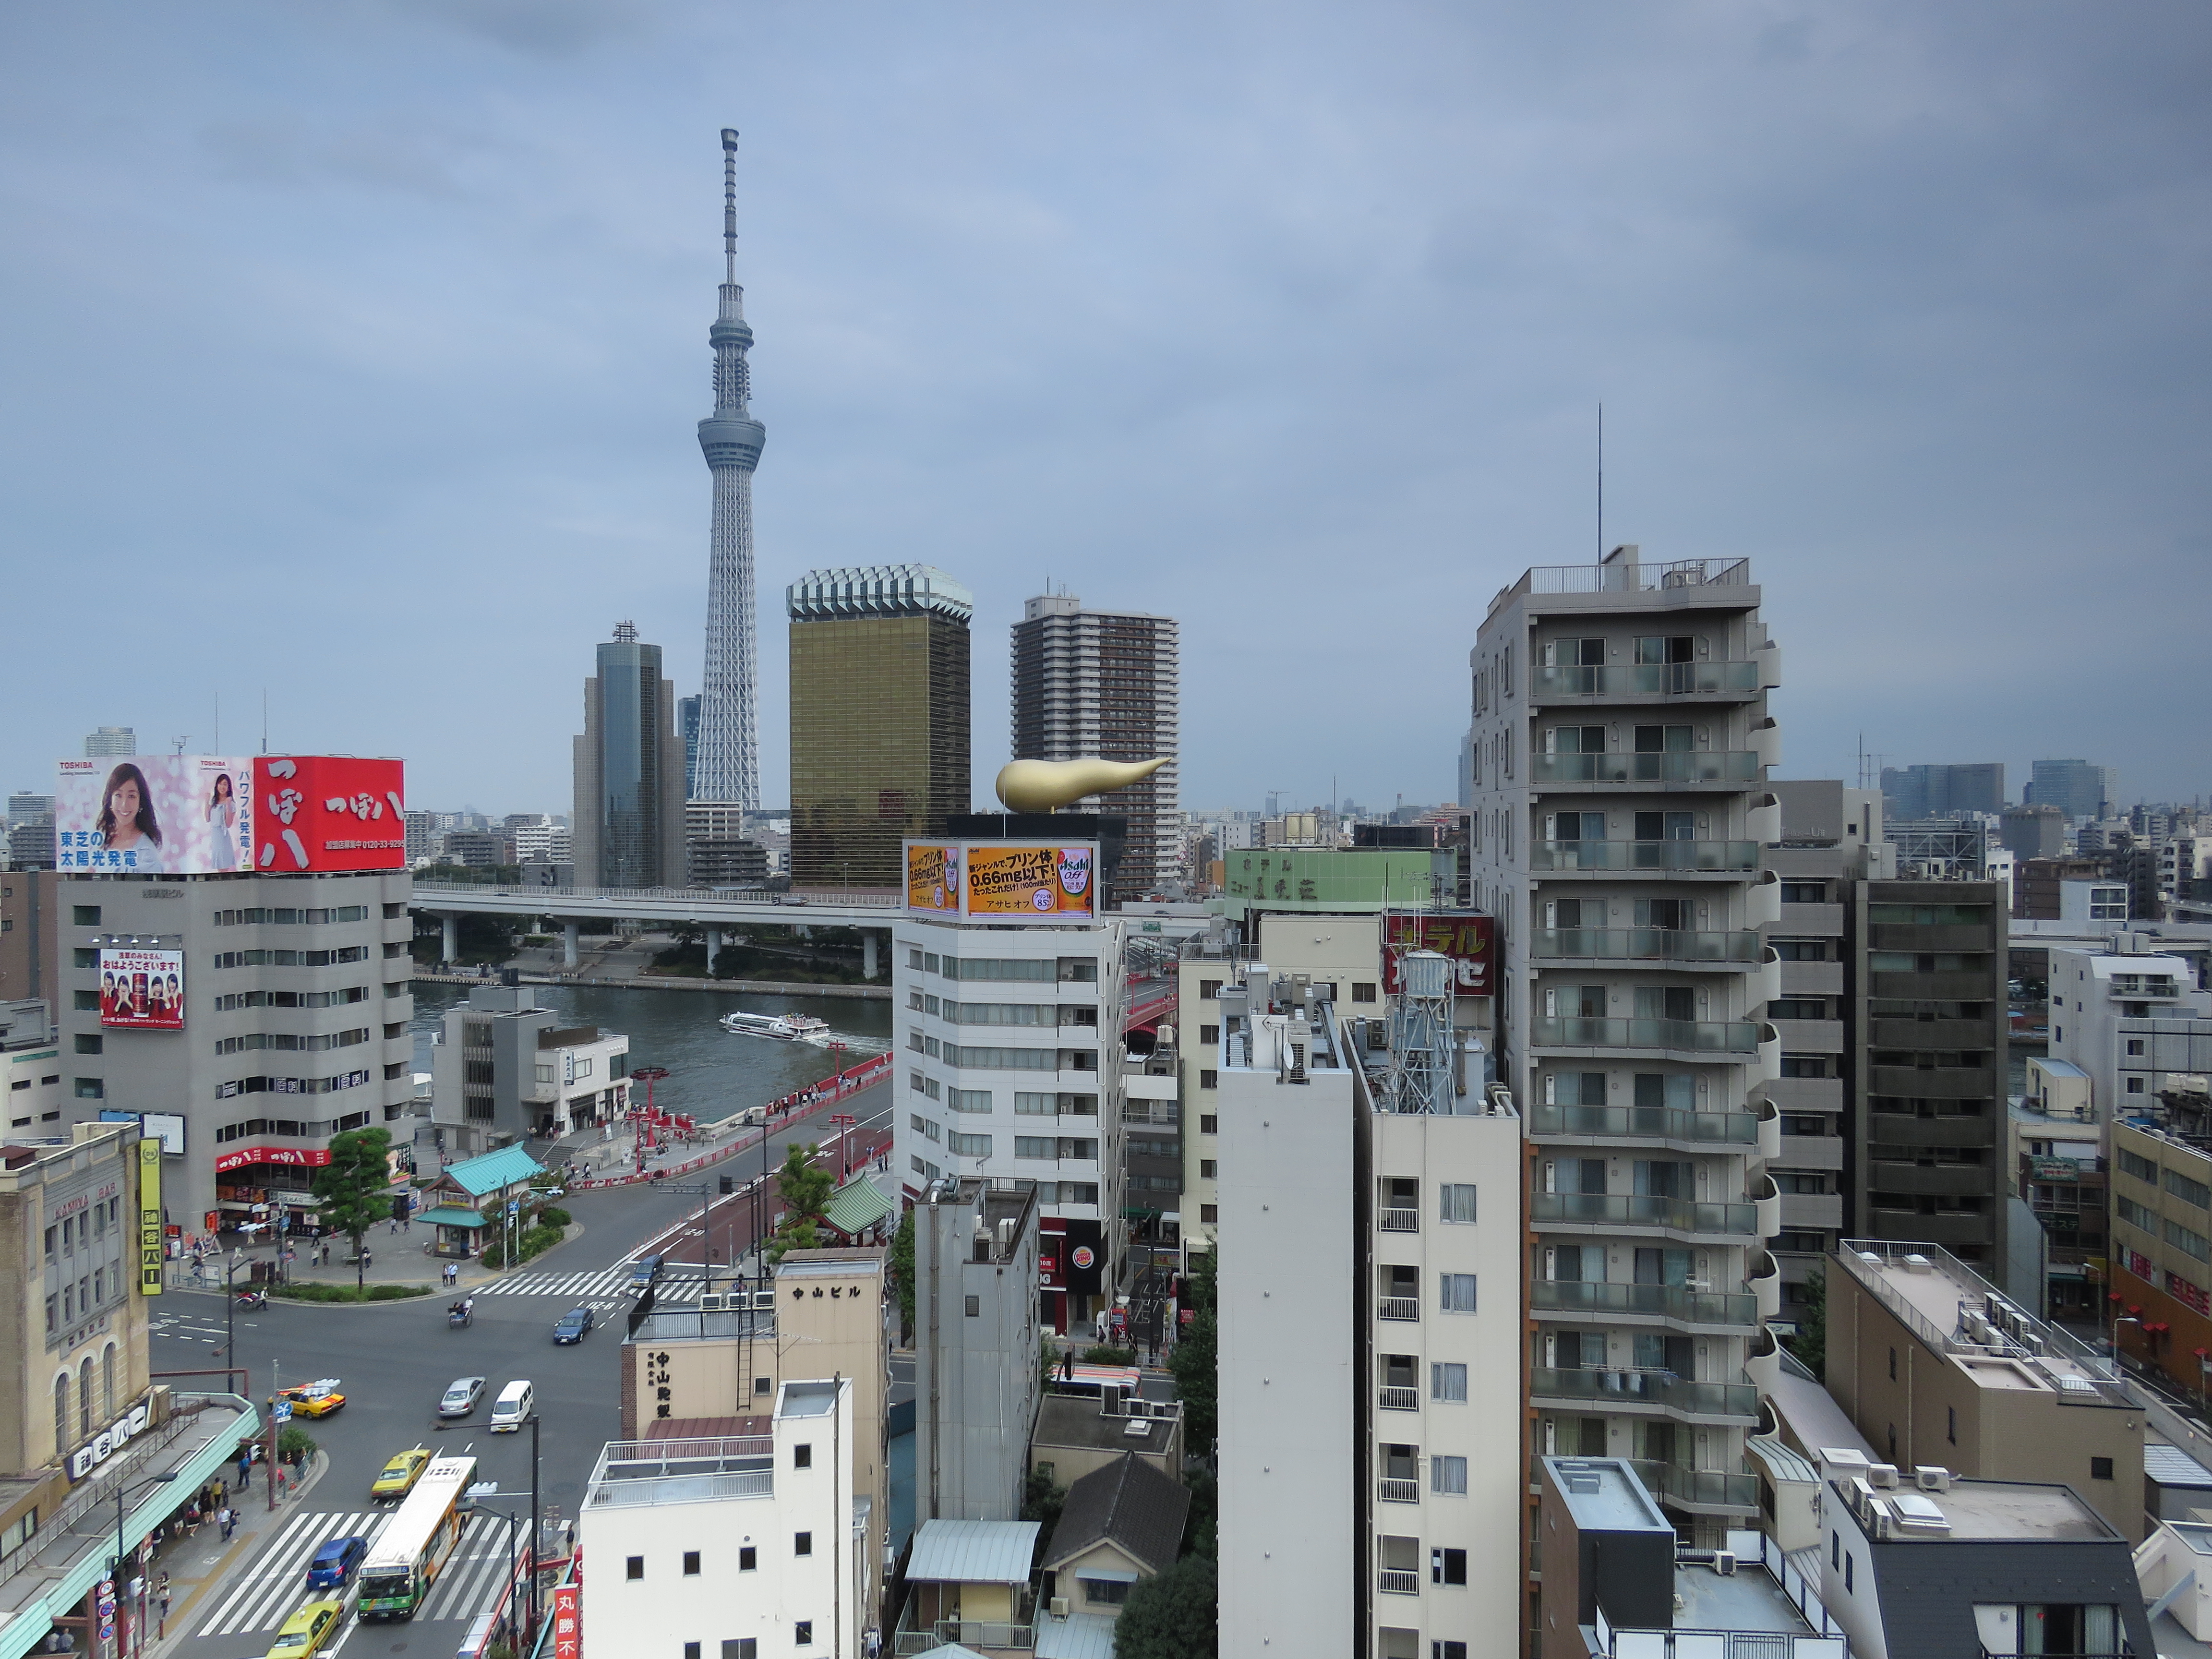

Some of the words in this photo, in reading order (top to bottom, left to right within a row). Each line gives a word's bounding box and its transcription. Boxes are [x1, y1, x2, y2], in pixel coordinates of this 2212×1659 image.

[326, 791, 405, 821] つぼ八
[60, 831, 104, 847] 東芝の
[60, 851, 138, 866] 太陽光発電
[1060, 857, 1089, 871] Asahi
[1243, 858, 1293, 871] ホテル
[970, 863, 1056, 888] 0.66mg以下!
[986, 900, 1011, 909] アサヒ
[1014, 900, 1030, 909] オフ
[1393, 925, 1486, 954] ホテル
[103, 960, 179, 972] おはようございます!
[270, 1150, 305, 1163] つぼ八
[792, 1286, 861, 1300] 中山ビル
[557, 1595, 576, 1657] 丸勝不
